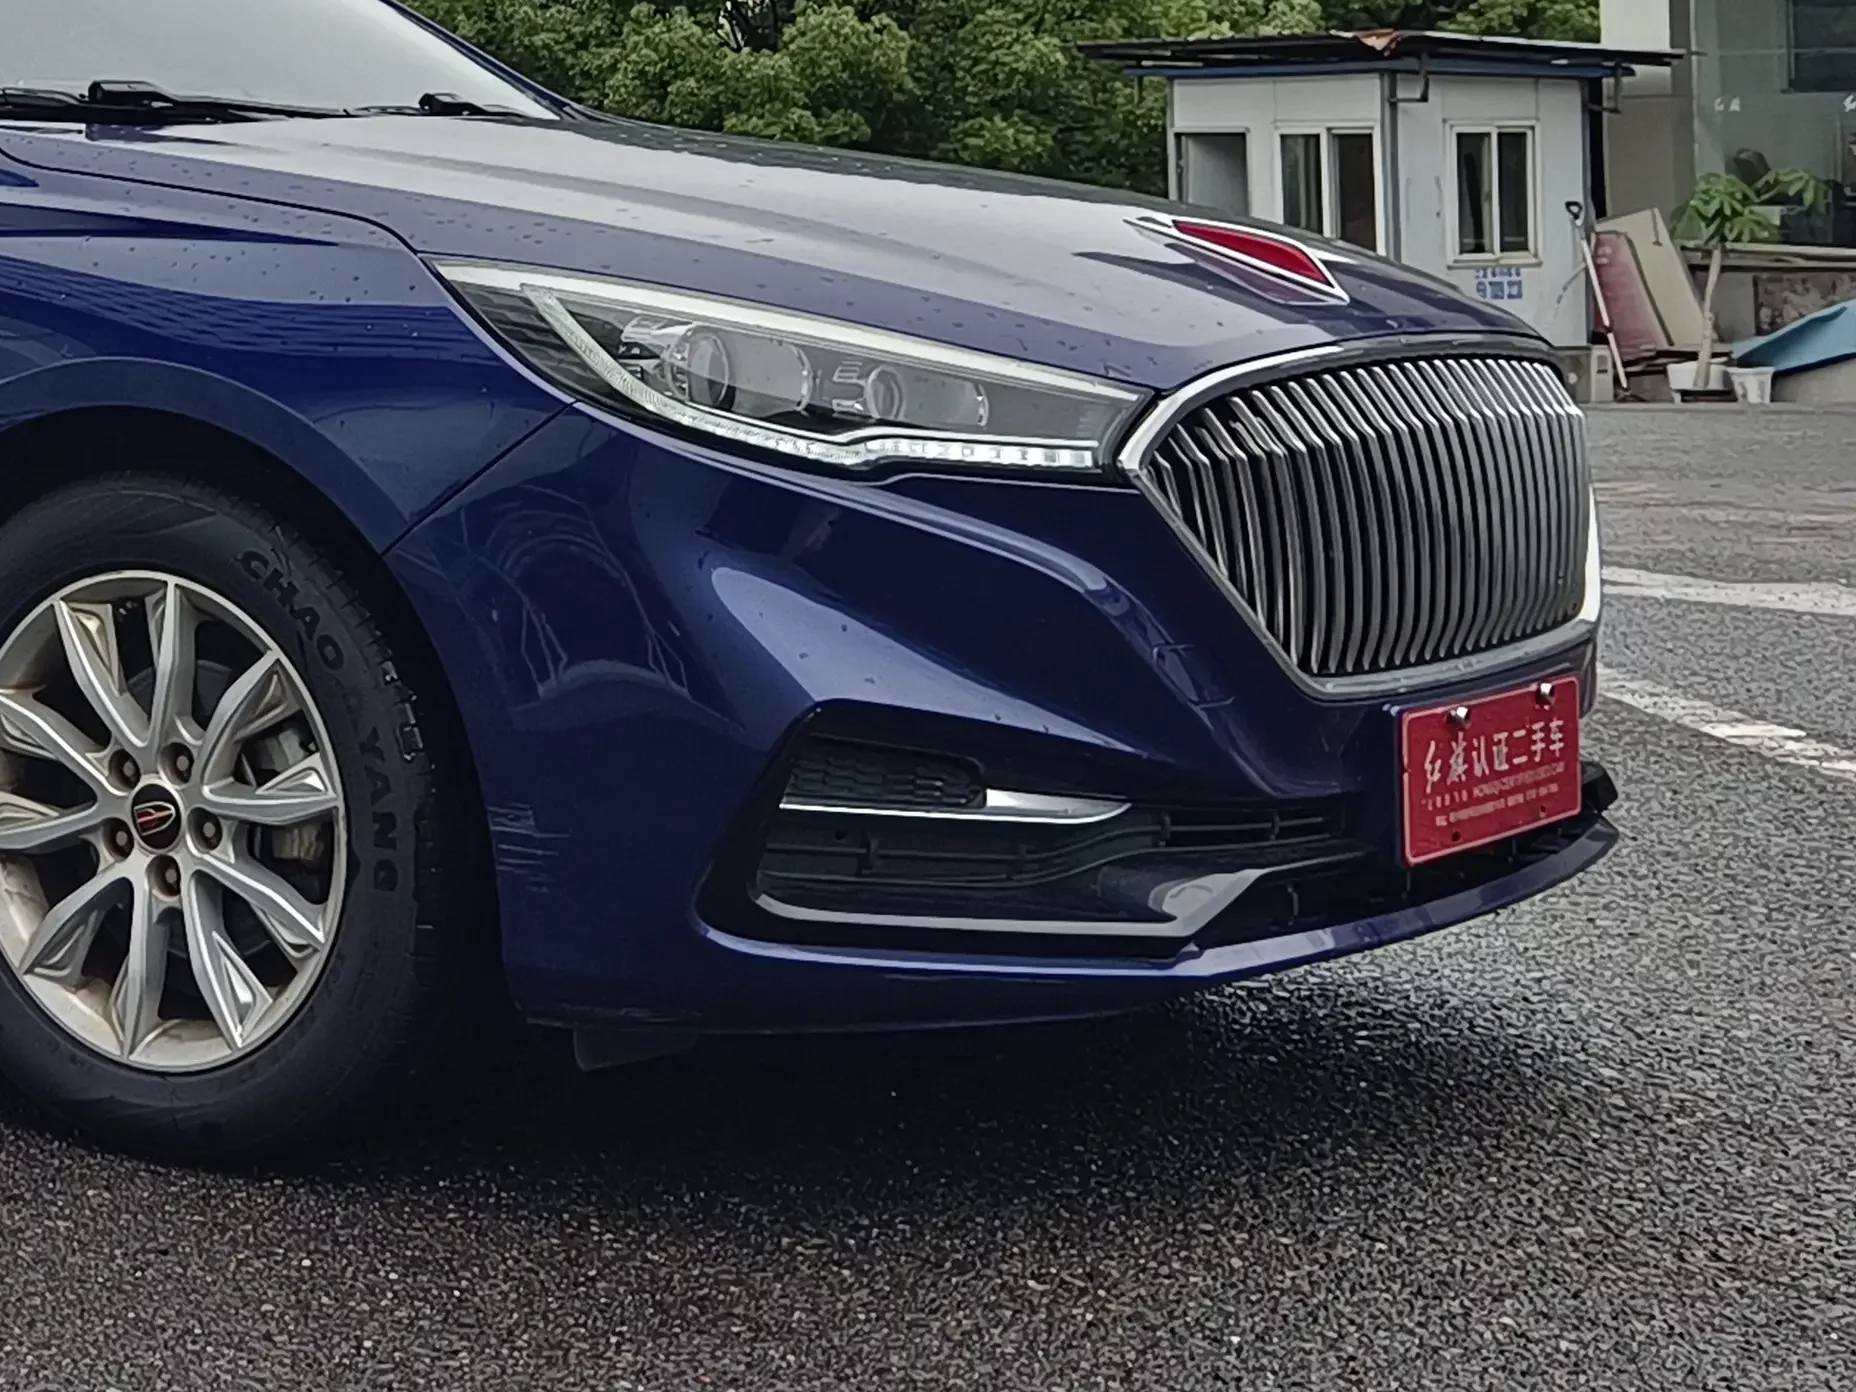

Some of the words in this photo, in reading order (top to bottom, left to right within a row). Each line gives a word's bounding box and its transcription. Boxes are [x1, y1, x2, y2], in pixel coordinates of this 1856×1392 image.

[239, 548, 346, 673] CHAO
[358, 725, 399, 893] YANG
[1424, 717, 1564, 794] 红旗认证二手车
